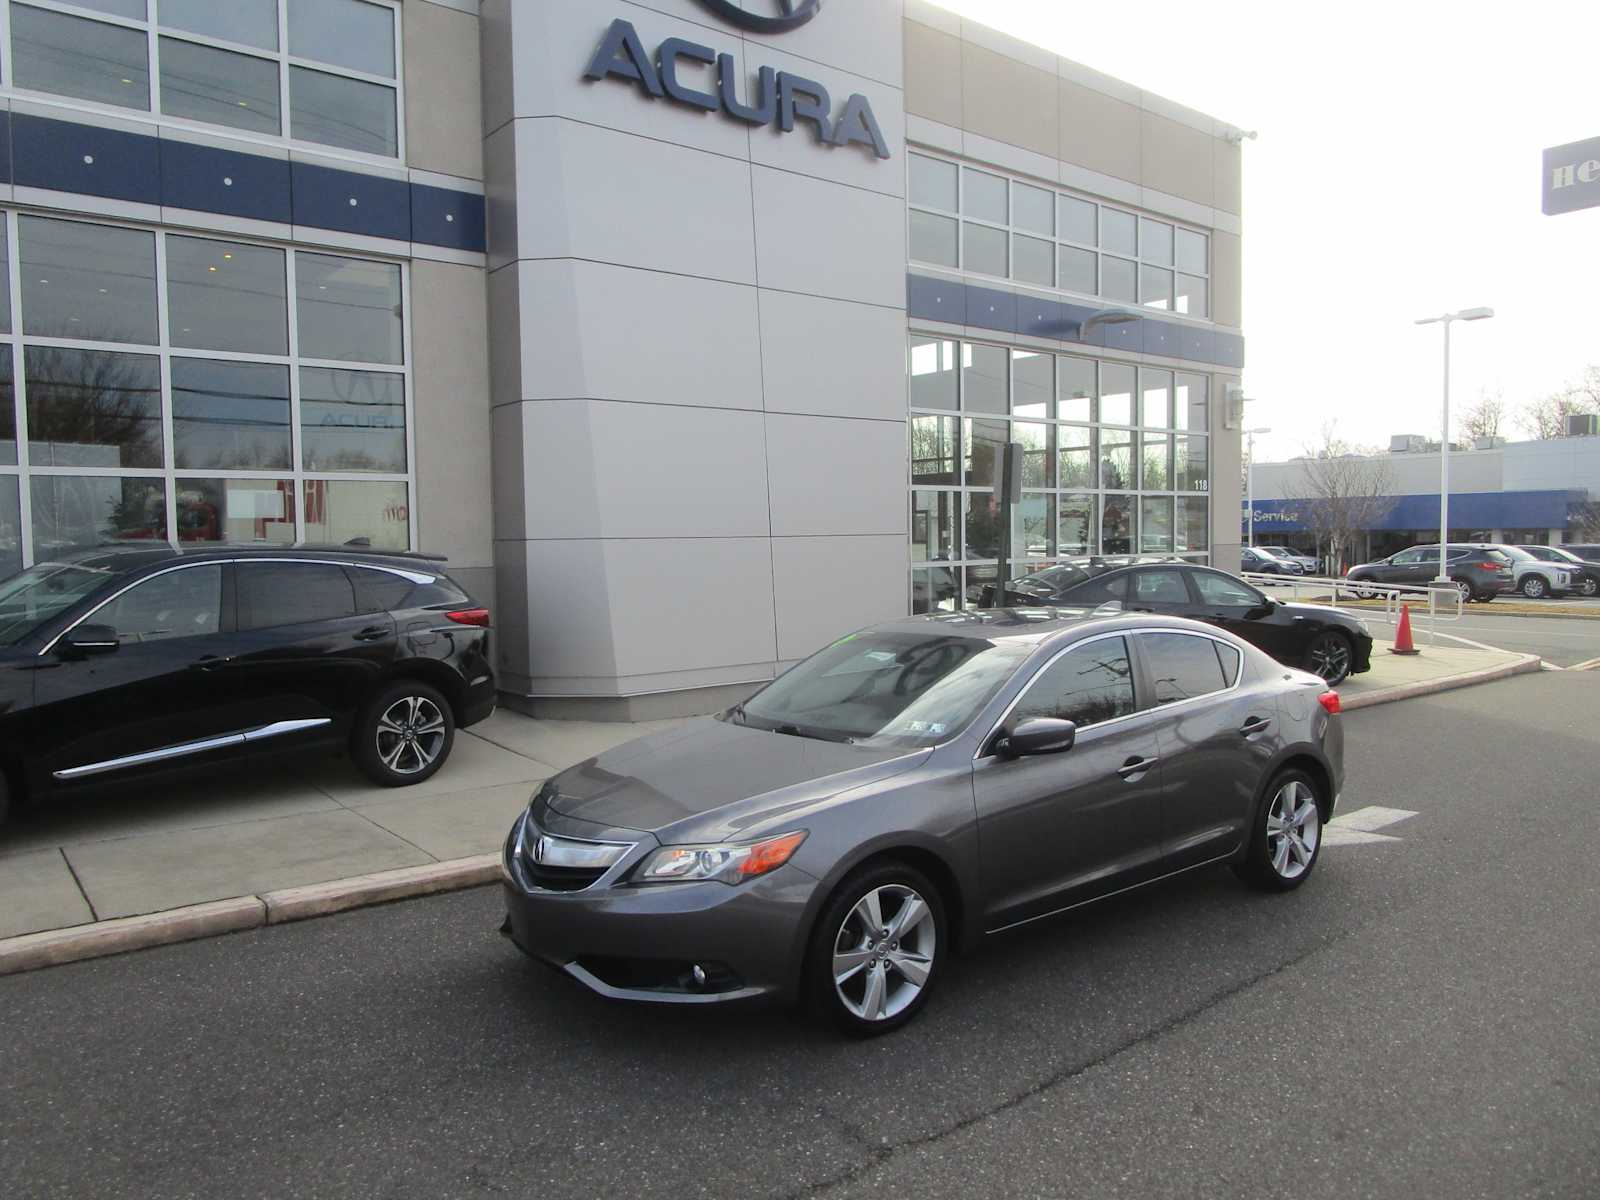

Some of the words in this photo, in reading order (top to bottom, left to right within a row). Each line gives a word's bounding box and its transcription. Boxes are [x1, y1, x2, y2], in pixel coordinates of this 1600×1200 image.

[583, 18, 889, 160] ACURA
[1194, 479, 1208, 491] 118
[1253, 511, 1298, 522] Service
